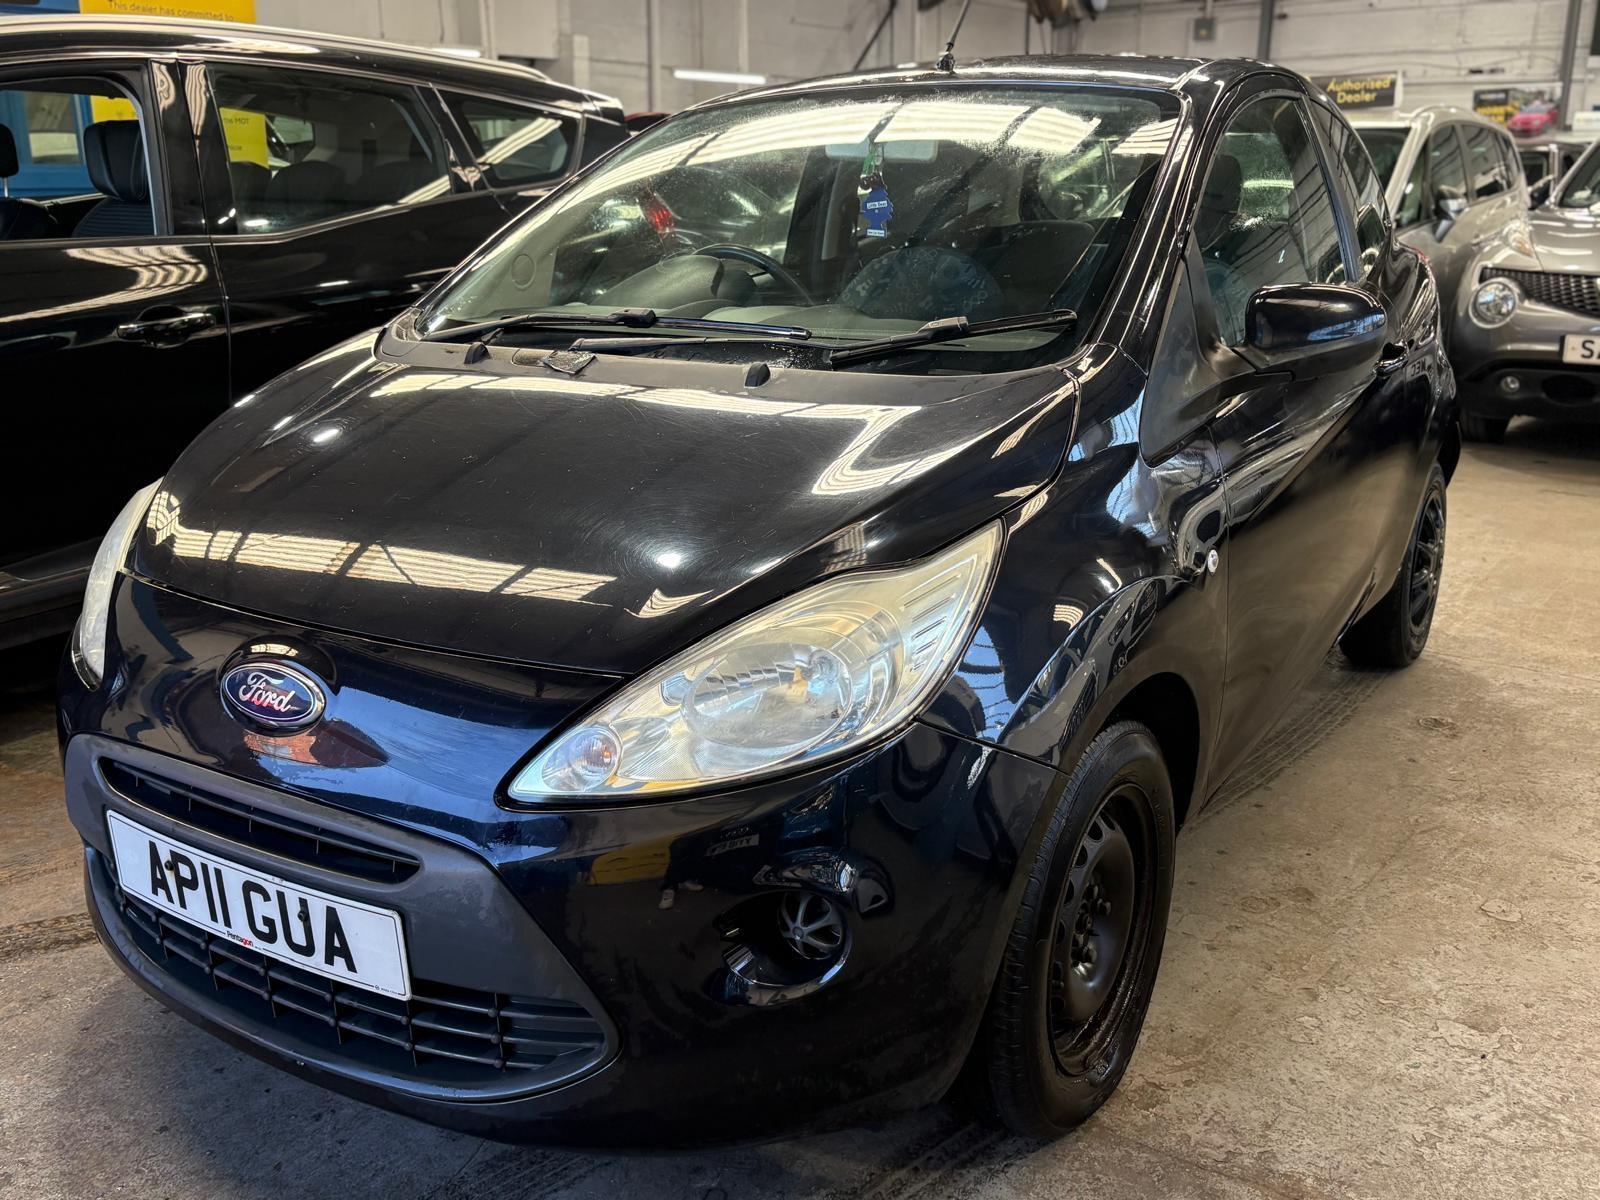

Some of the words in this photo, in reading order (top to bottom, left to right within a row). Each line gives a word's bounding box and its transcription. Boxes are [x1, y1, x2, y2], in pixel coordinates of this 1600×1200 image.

[109, 1, 127, 11] This
[131, 3, 157, 14] dealer
[160, 5, 175, 16] has
[177, 8, 223, 21] committed
[224, 12, 234, 22] to
[1326, 75, 1393, 92] Authorised
[1337, 90, 1377, 104] Dealer
[234, 117, 250, 125] MOT
[1581, 339, 1600, 359] S
[239, 671, 302, 712] Ford
[148, 840, 232, 929] AP11
[241, 879, 358, 974] GUA
[226, 930, 254, 947] Pentagon
